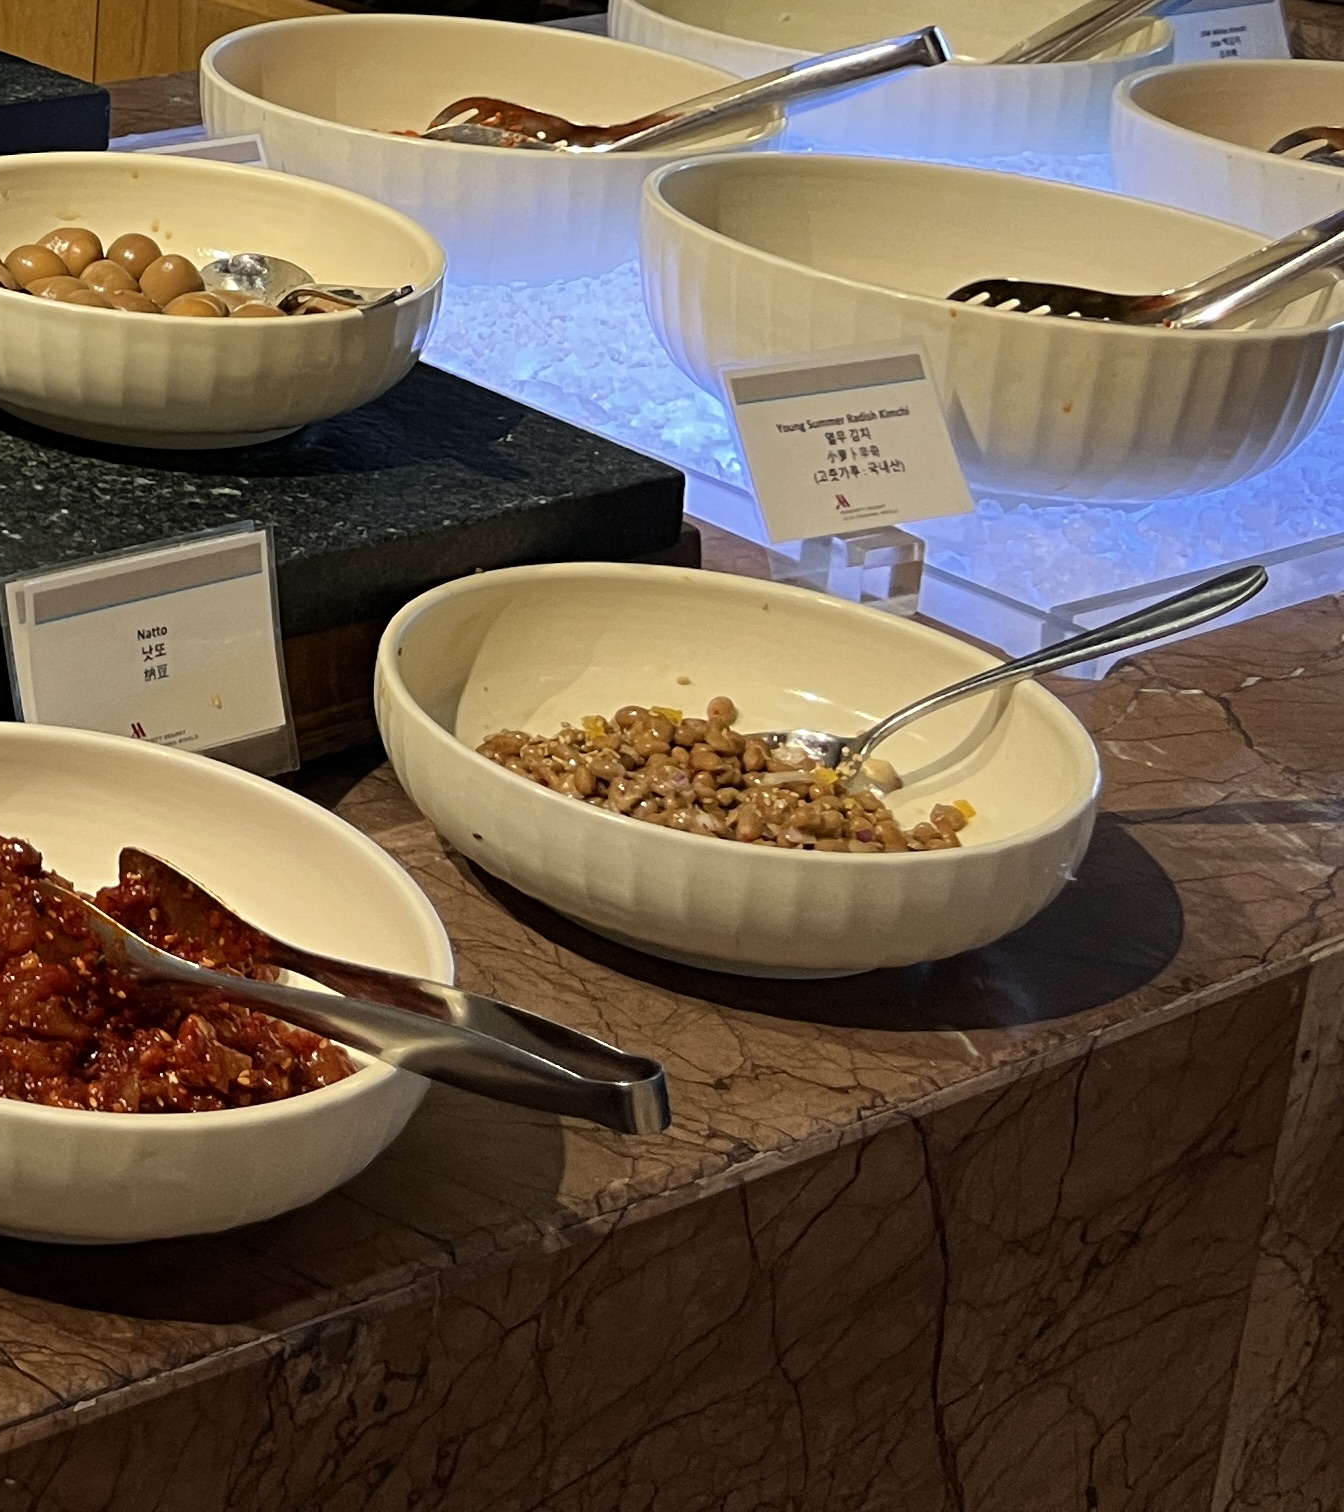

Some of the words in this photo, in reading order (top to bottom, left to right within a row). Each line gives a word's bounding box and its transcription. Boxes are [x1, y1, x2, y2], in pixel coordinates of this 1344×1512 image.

[776, 422, 807, 434] Young
[137, 625, 168, 642] Natto
[142, 643, 168, 662] 낫또
